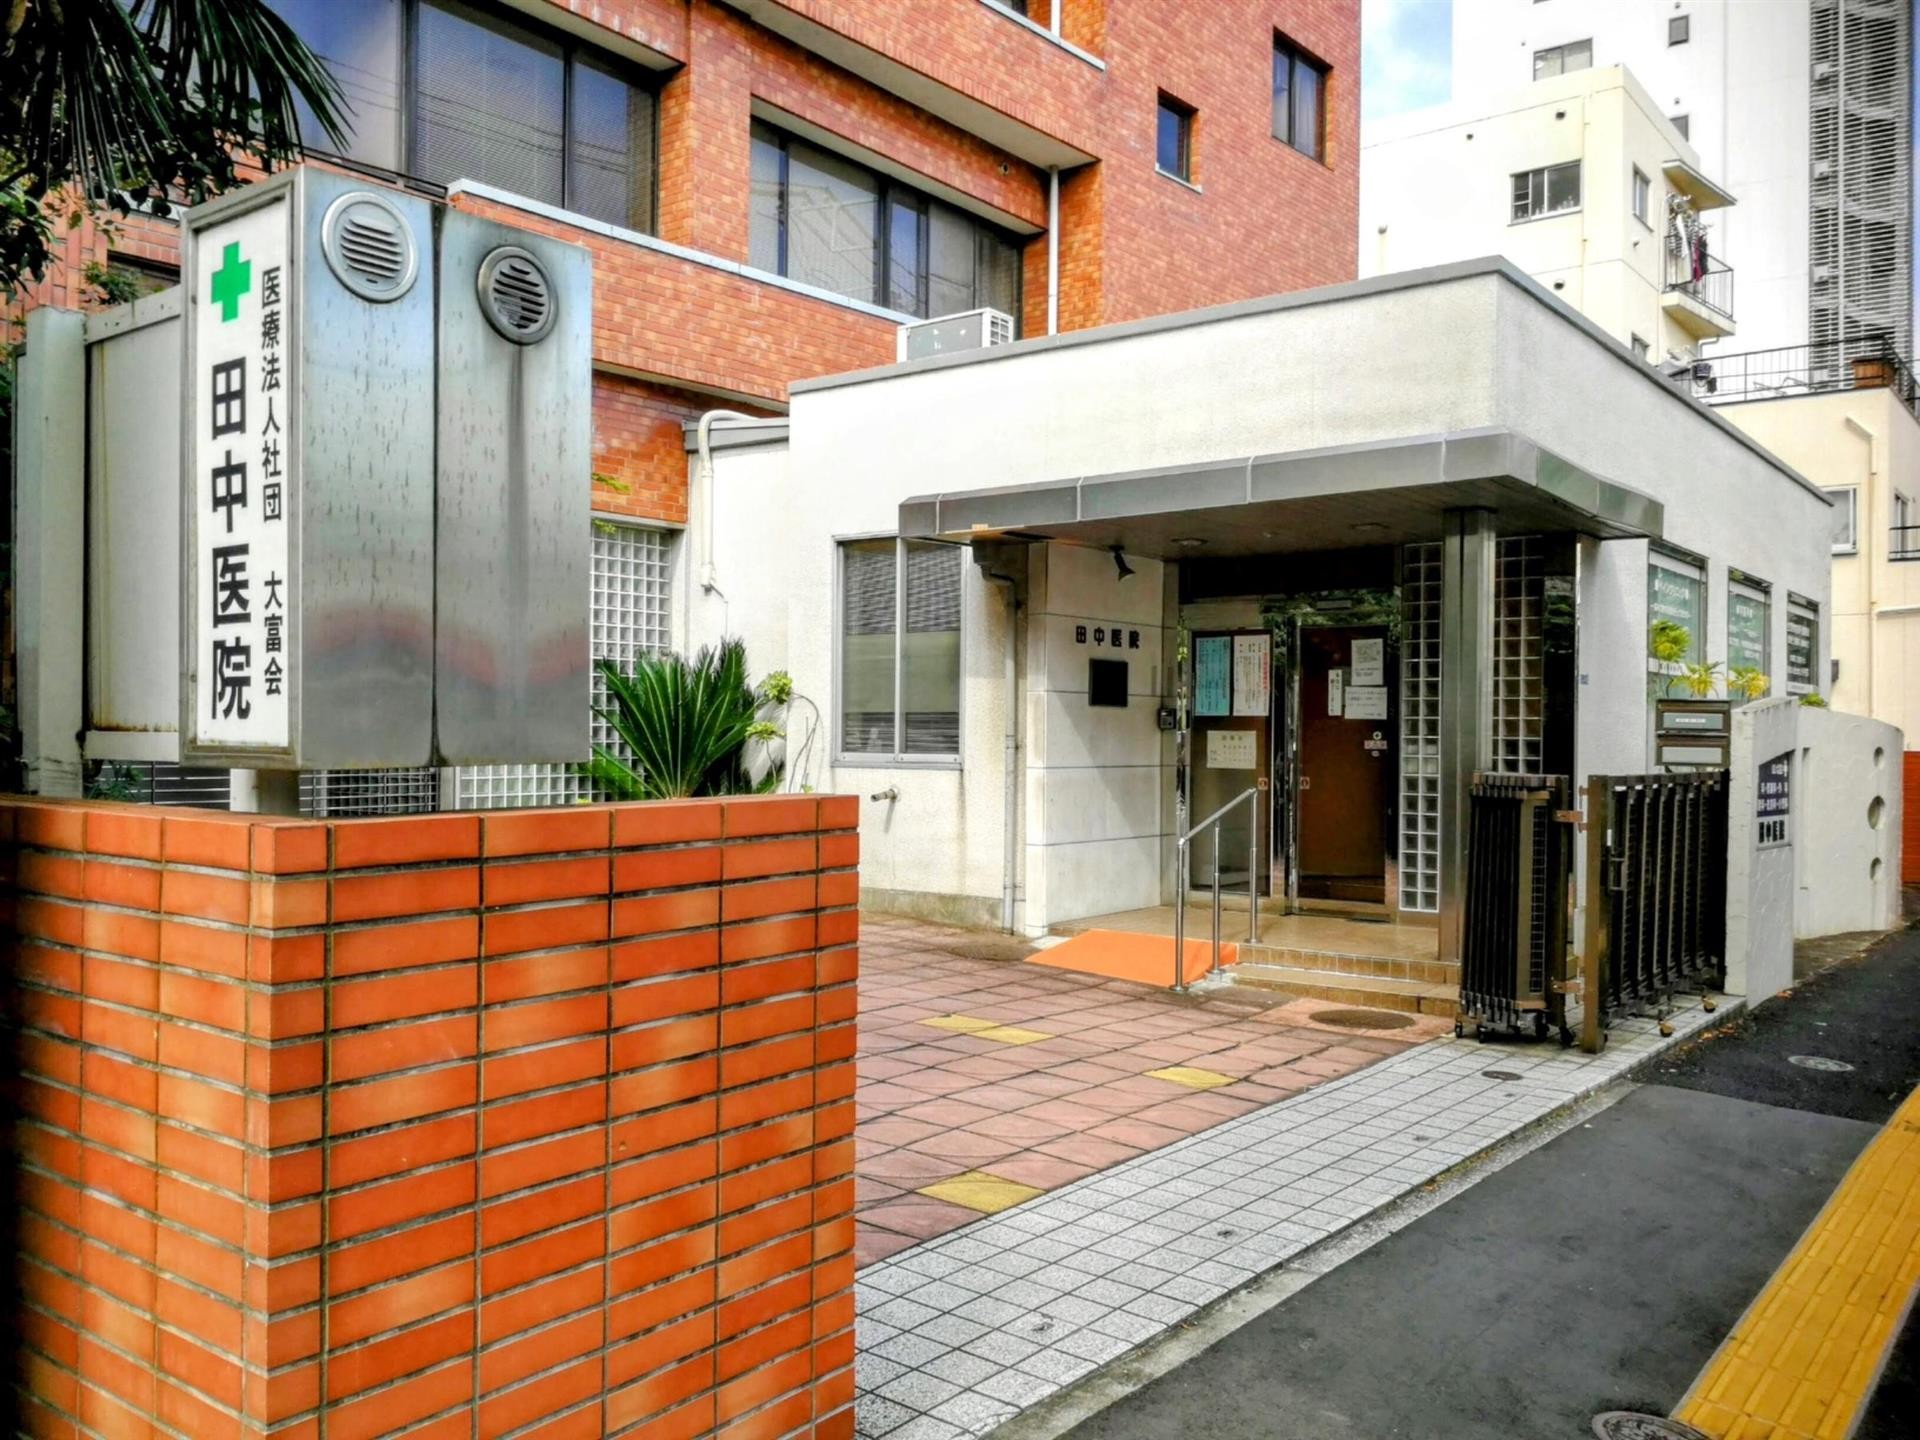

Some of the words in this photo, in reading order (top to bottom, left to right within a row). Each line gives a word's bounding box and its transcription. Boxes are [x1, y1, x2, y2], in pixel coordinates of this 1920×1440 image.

[261, 266, 282, 522] 医療法人社団
[211, 357, 252, 720] 田中医院
[264, 571, 283, 697] 大富会
[1075, 625, 1140, 649] 田中医院
